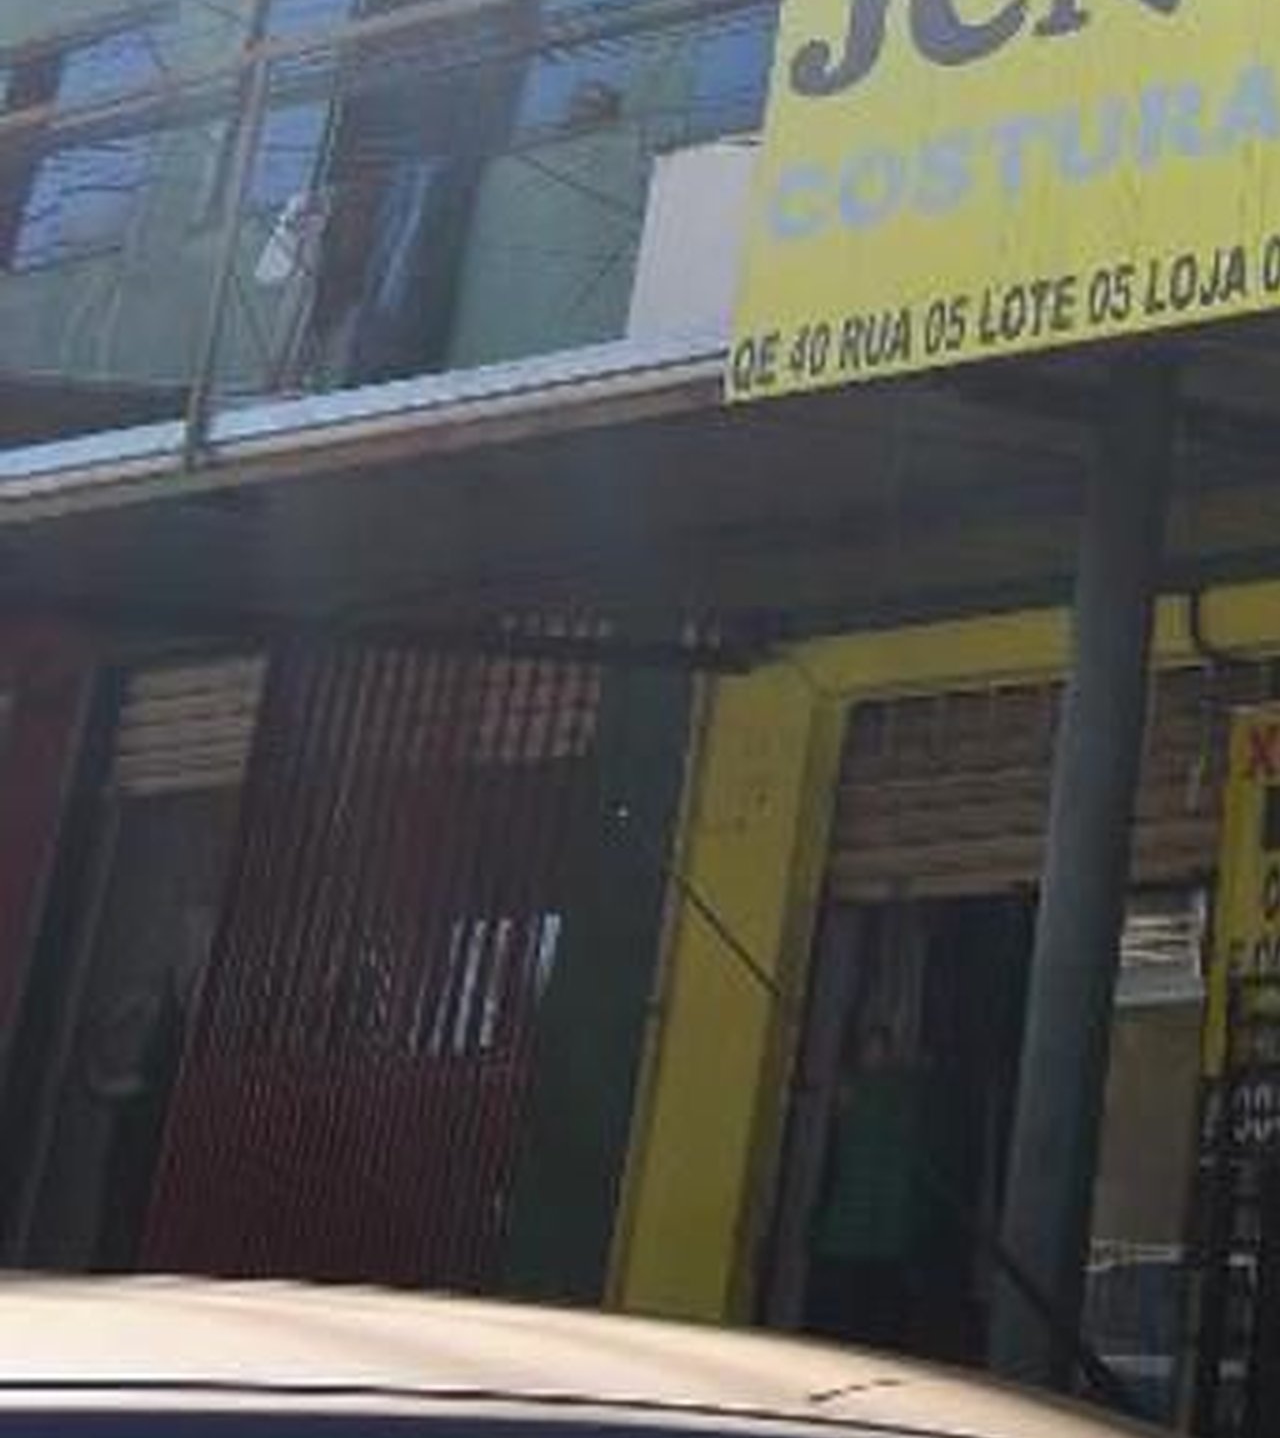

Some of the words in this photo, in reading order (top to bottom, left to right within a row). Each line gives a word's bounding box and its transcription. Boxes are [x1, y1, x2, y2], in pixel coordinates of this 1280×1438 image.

[838, 309, 911, 369] RUA
[925, 296, 967, 352] 05
[978, 273, 1077, 345] LOTE
[1088, 264, 1136, 323] 05
[1143, 245, 1248, 314] LOJA
